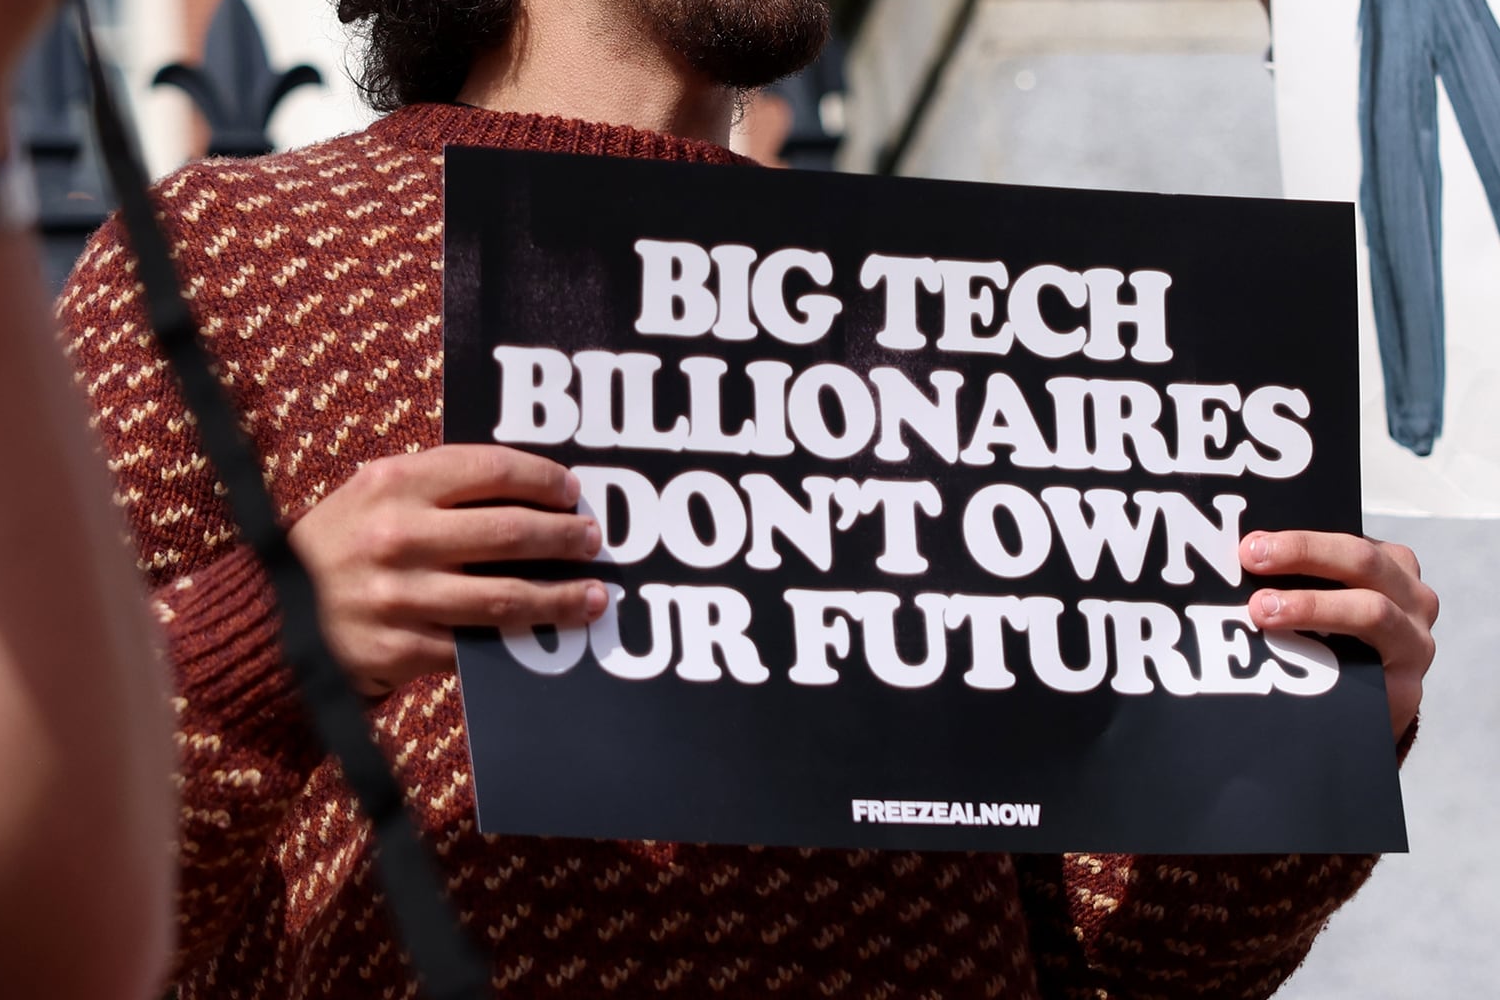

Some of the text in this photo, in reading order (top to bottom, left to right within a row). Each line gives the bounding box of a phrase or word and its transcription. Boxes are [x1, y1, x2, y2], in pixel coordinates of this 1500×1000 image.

[634, 239, 1174, 364] BIG TECH
[492, 345, 1313, 479] BILLIONAIRES
[570, 465, 1248, 588] DON'T OWN
[783, 588, 1341, 697] FUTURES
[851, 799, 1041, 827] FREEZEAI.NOW
